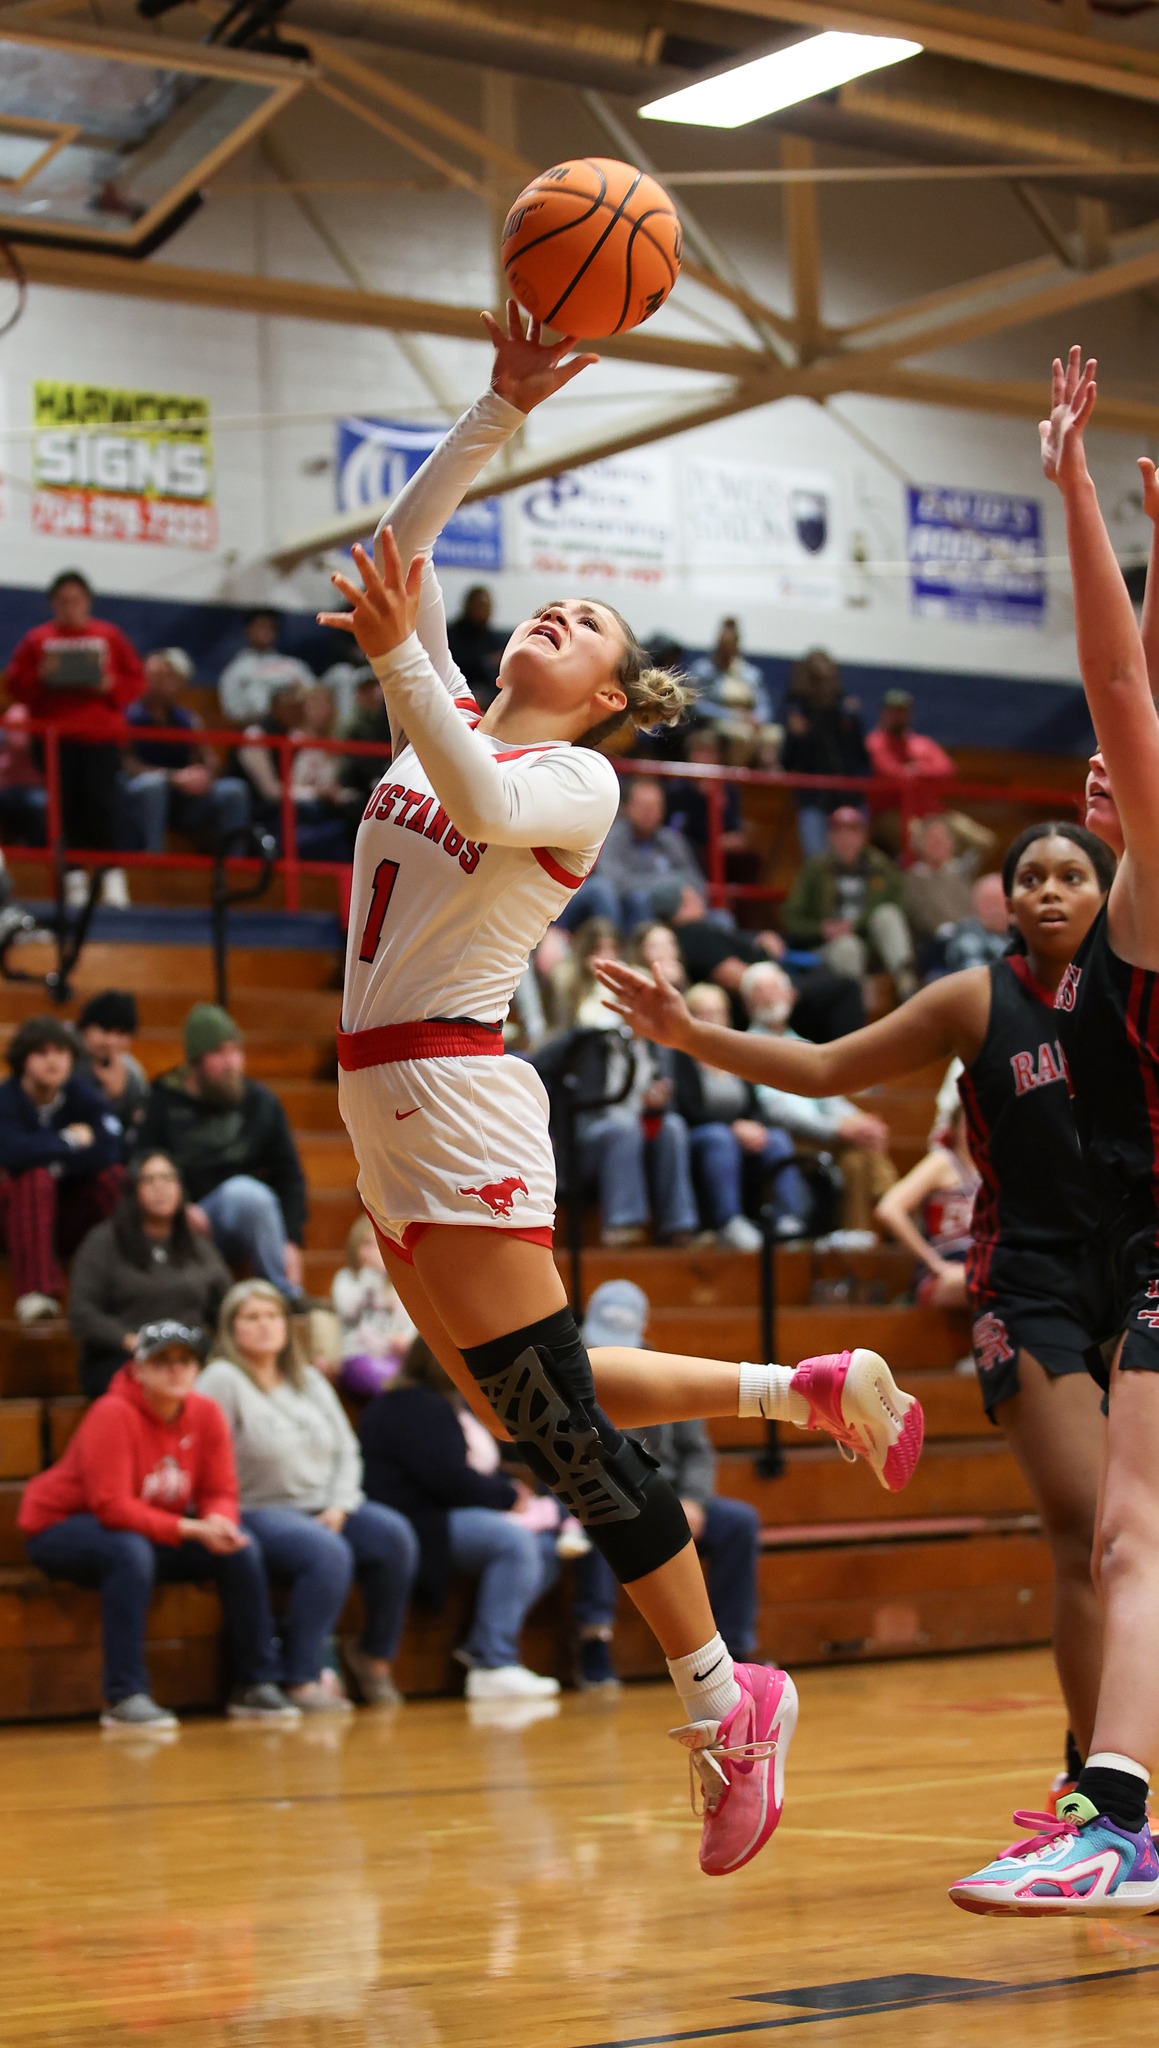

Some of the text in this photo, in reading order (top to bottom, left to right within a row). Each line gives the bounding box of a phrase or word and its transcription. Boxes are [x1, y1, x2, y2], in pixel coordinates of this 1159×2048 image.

[38, 432, 208, 495] SIGNS
[362, 783, 487, 874] USTANGS
[359, 858, 400, 964] 1
